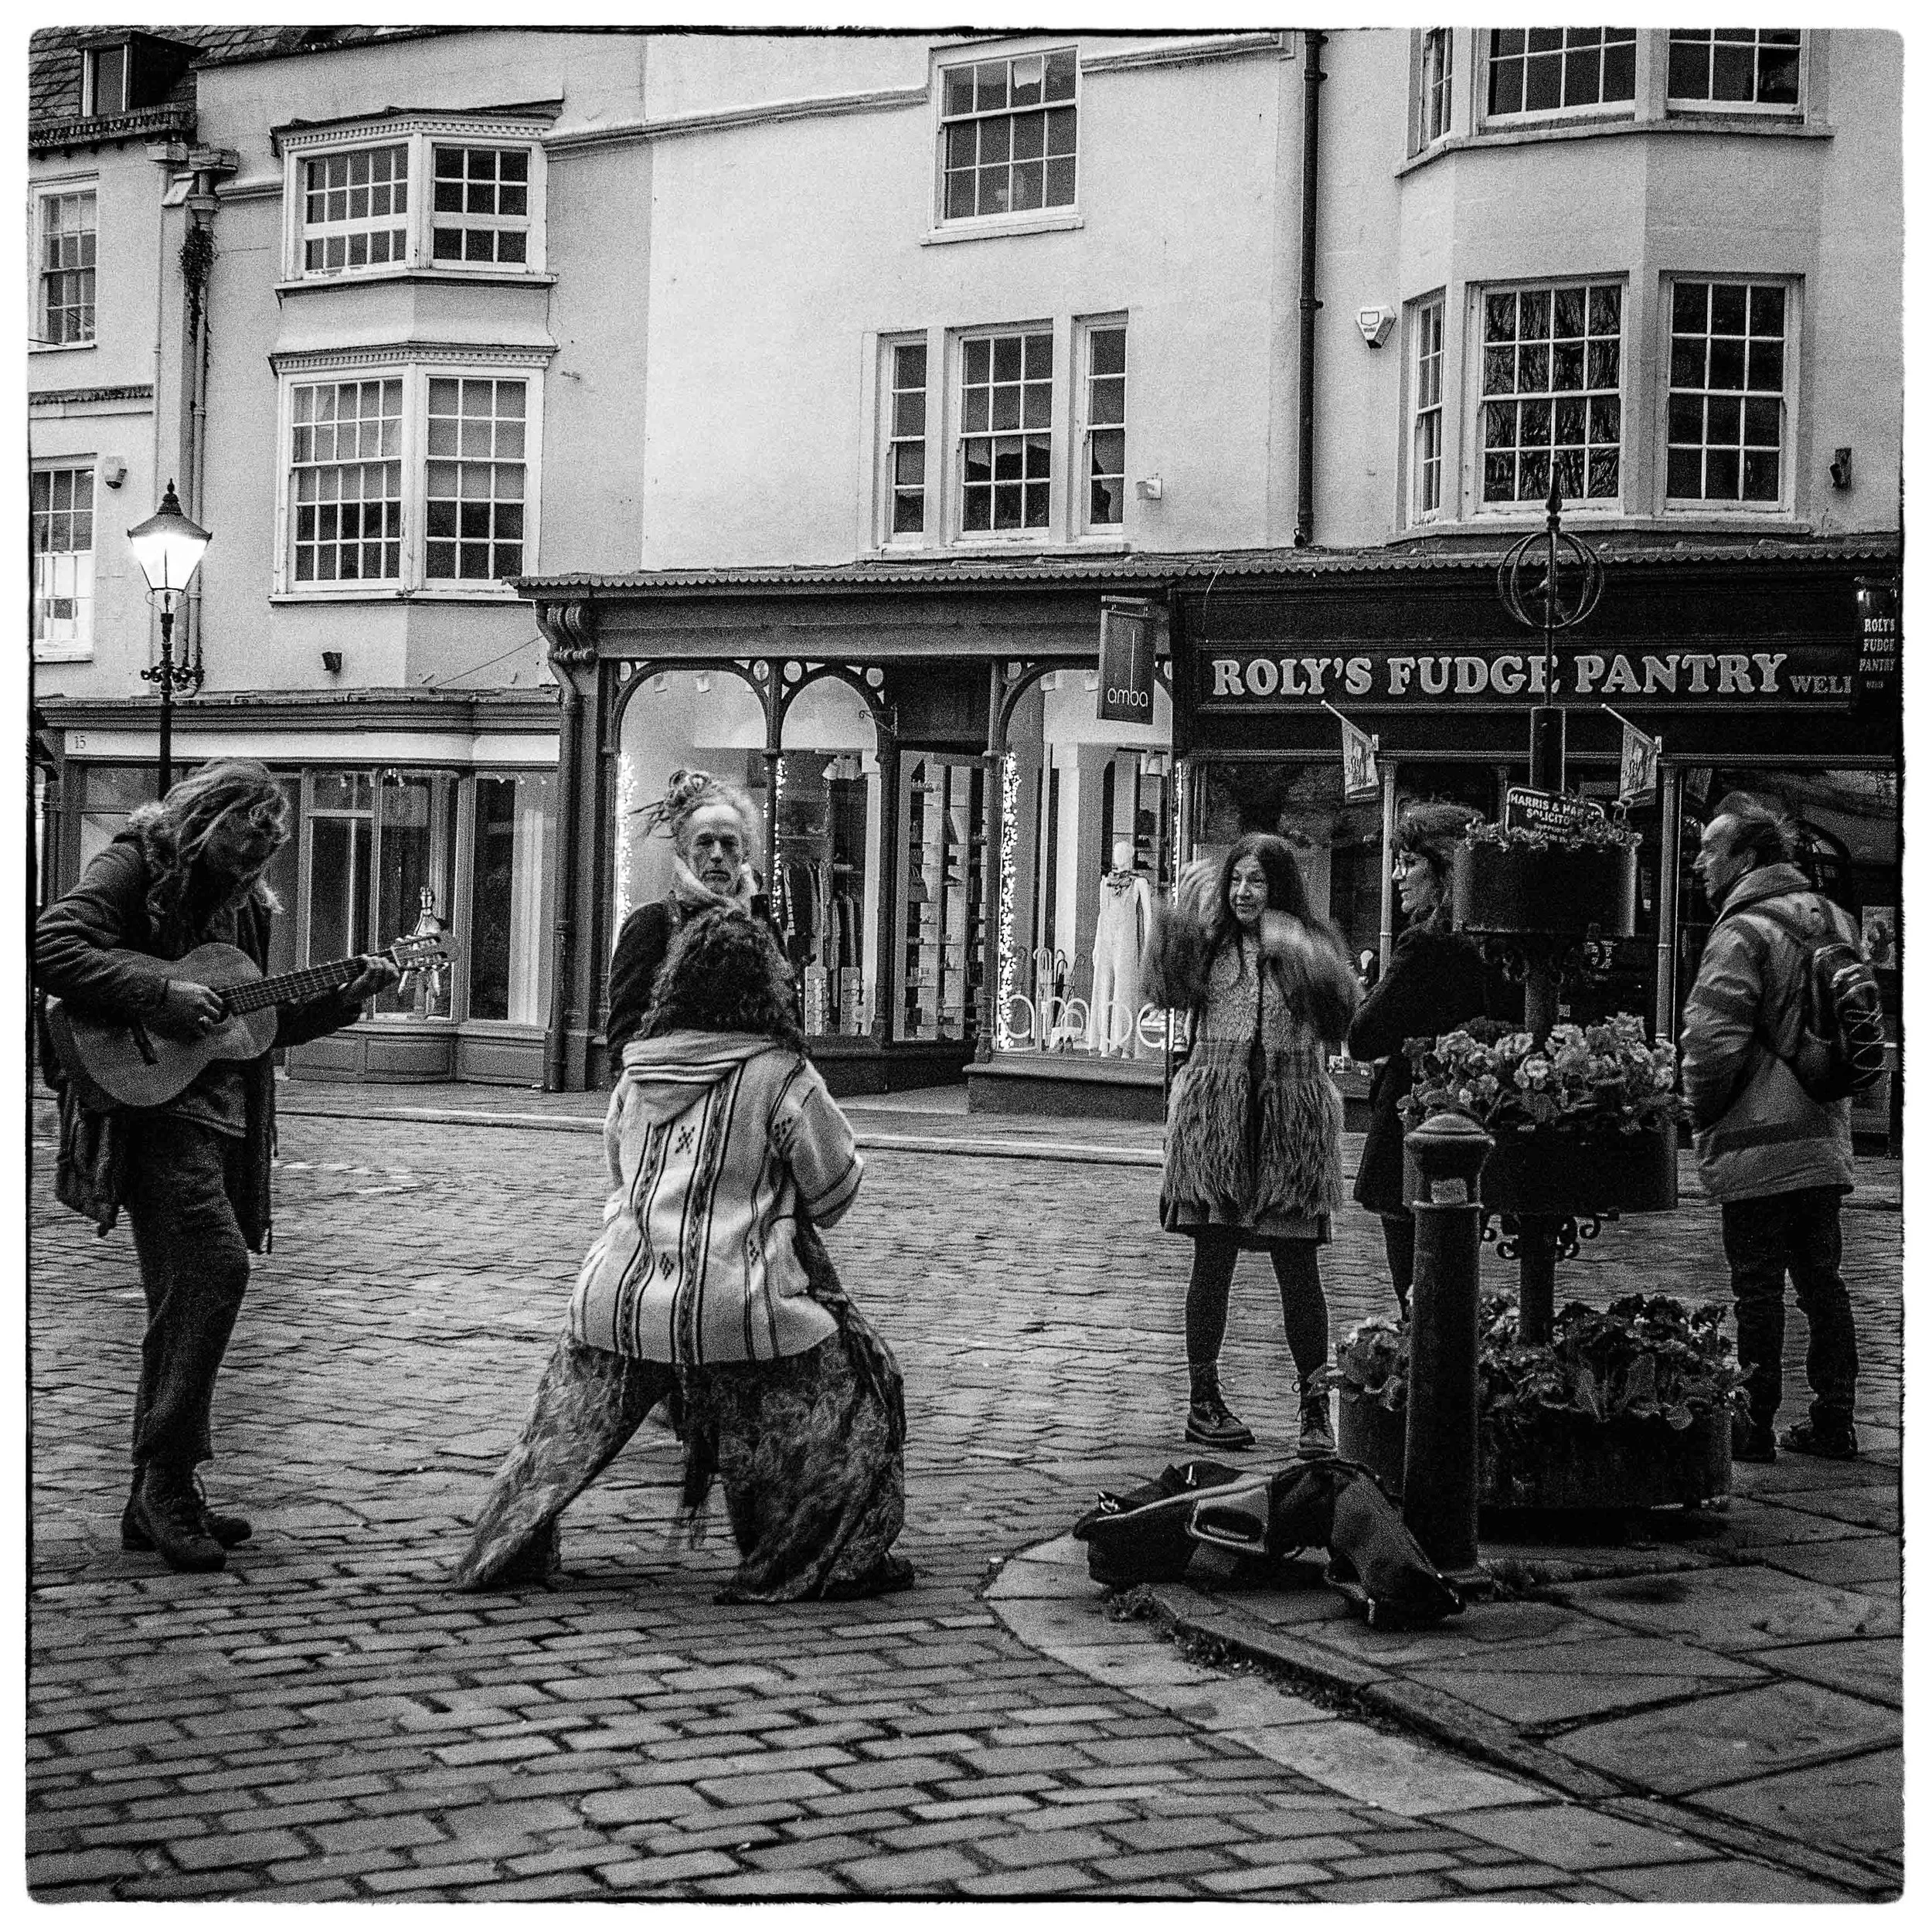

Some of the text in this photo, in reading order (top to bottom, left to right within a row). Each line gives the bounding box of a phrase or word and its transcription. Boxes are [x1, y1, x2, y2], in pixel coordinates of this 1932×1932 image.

[1212, 654, 1787, 696] ROLY'S FUDGE PANTRY
[75, 735, 87, 750] 15
[1510, 793, 1549, 811] HARRIS
[1552, 802, 1560, 813] &
[1526, 808, 1571, 825] SOLICITO
